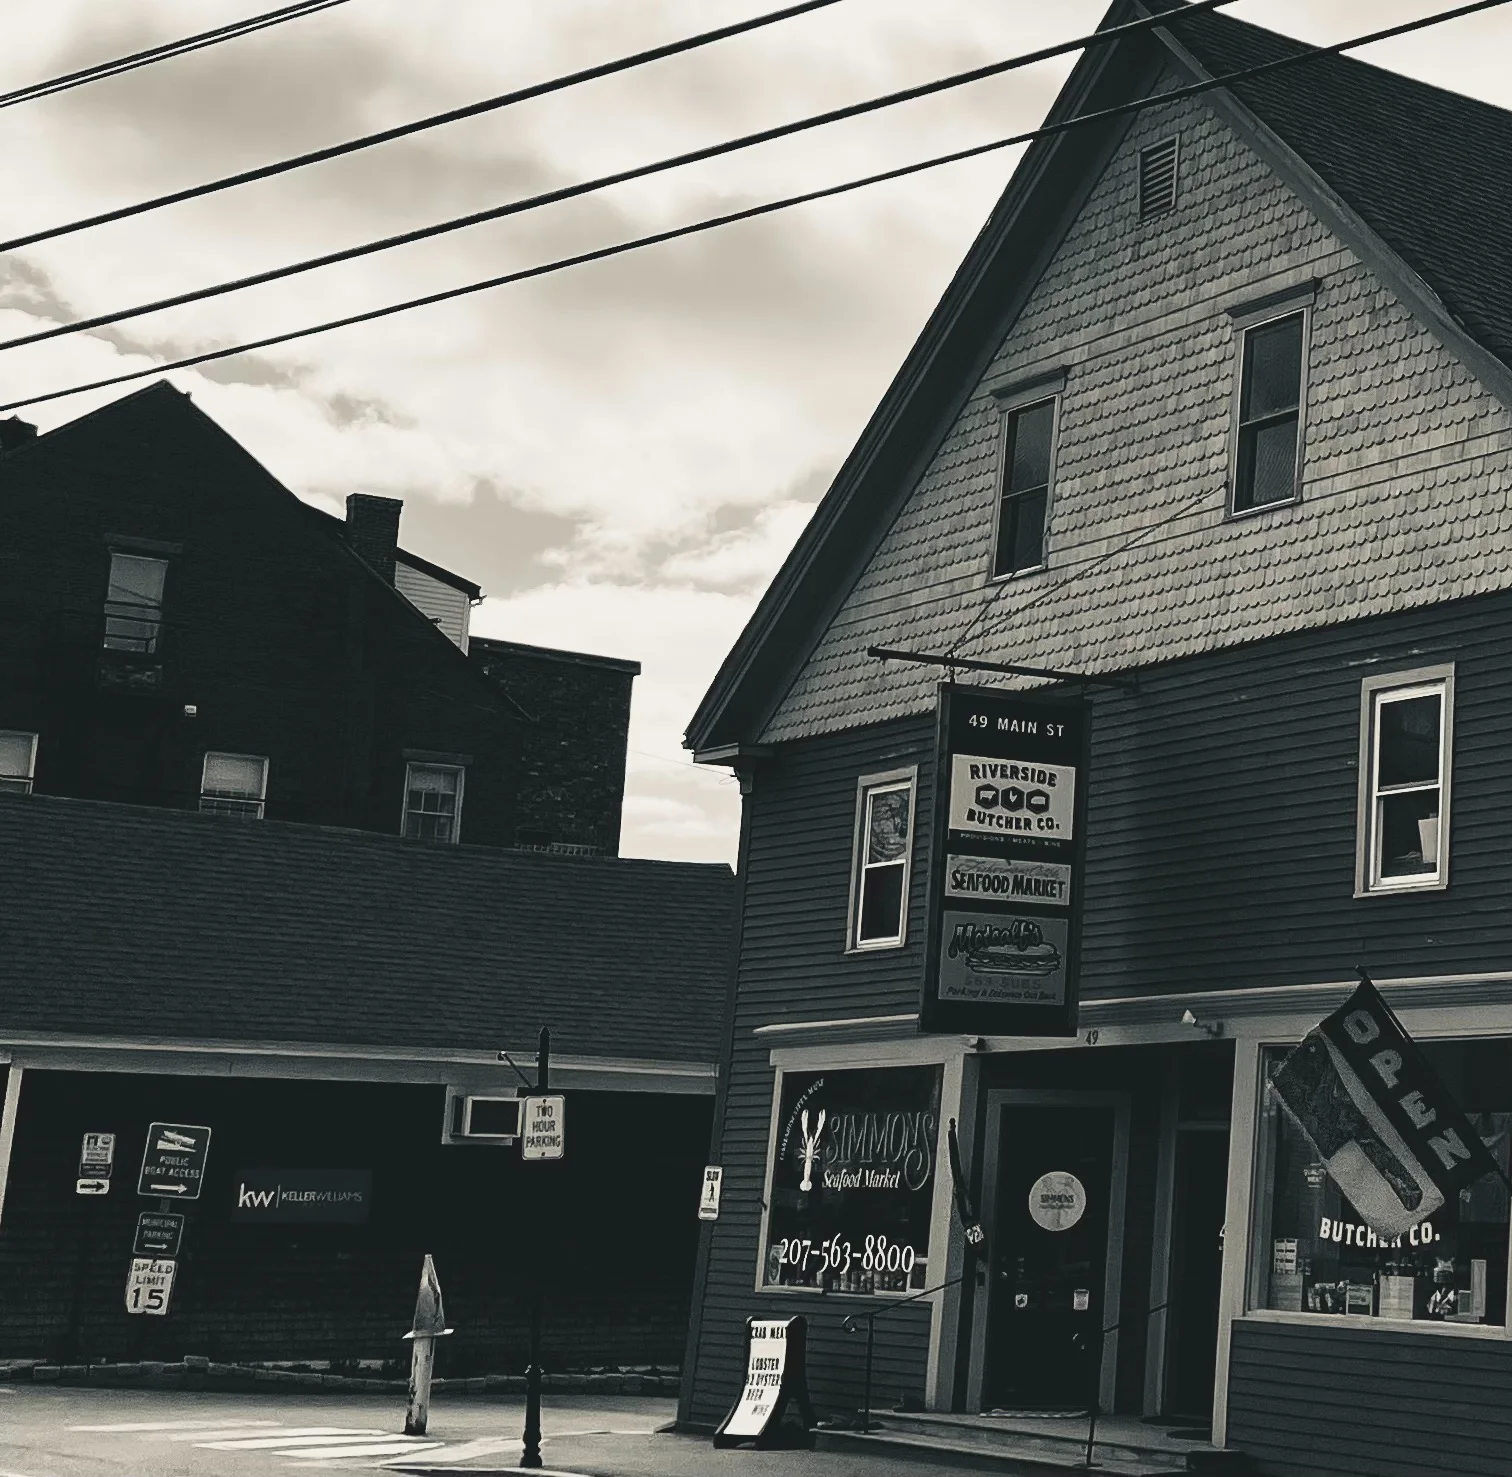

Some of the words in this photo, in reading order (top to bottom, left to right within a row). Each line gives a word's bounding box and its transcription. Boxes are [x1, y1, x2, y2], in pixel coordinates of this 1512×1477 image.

[968, 714, 988, 728] 49
[997, 717, 1038, 735] MAIN
[1046, 723, 1065, 737] ST
[969, 763, 1058, 788] RIVERSIDE
[966, 807, 1033, 831] BUTCHER
[1036, 817, 1061, 831] CO.
[951, 869, 1011, 894] SEAFOOD
[1010, 873, 1066, 899] MARKET
[1085, 1029, 1099, 1045] 49
[1342, 1009, 1472, 1170] OPEN
[536, 1104, 553, 1118] TWO
[532, 1120, 555, 1133] HOUR
[526, 1134, 561, 1148] PARKING
[826, 1112, 934, 1191] SIMMONS
[144, 1165, 166, 1176] BOAT
[168, 1168, 200, 1179] ACCESS
[159, 1155, 189, 1167] PUBLIC
[822, 1168, 862, 1191] Seafood
[863, 1168, 901, 1189] Market
[238, 1182, 275, 1208] kw
[1409, 1221, 1441, 1247] CO.
[779, 1232, 916, 1275] 207-563-8800
[134, 1262, 173, 1275] SPEED
[135, 1275, 166, 1286] LIMIT
[133, 1287, 164, 1311] 15
[751, 1357, 780, 1371] LOBSTER
